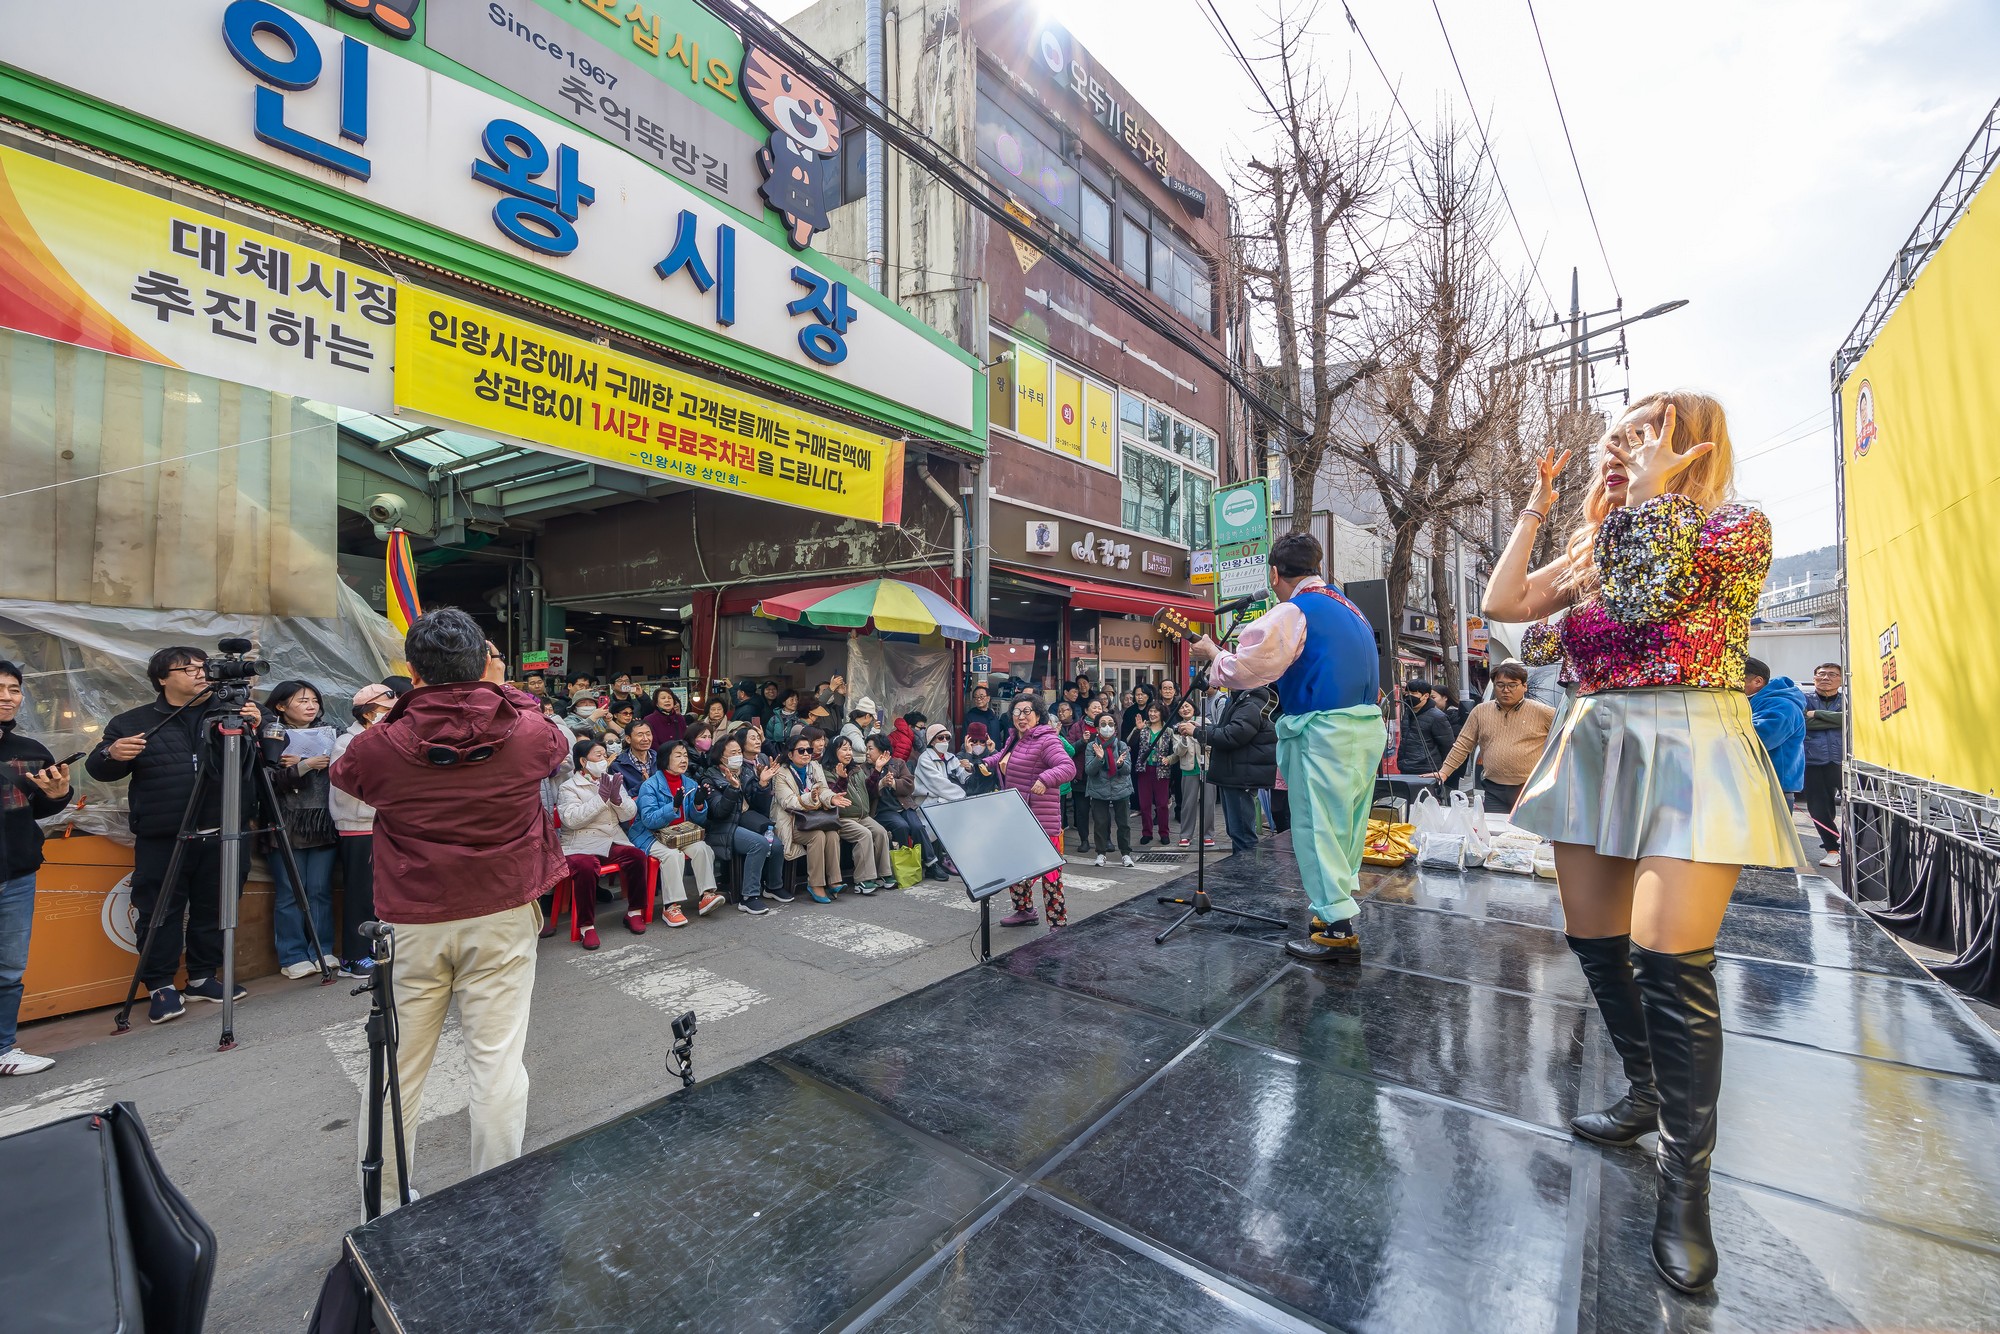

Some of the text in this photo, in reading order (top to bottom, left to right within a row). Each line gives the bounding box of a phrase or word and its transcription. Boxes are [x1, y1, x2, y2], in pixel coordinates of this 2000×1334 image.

[566, 0, 737, 103] 오십시오
[558, 75, 728, 194] 추억뚝방길
[1124, 111, 1169, 177] 당구장
[221, 0, 858, 366] 인왕시장
[1173, 180, 1203, 200] 394-5696
[172, 219, 396, 325] 대체시장
[131, 270, 374, 374] 추진하는
[428, 310, 871, 472] 인왕시장에서 구매한 고객분들께는 구매금액에
[474, 368, 847, 495] 상관없이 1시간 무료주차권을 드립니다.
[1018, 384, 1044, 407] 나루터
[1221, 554, 1265, 570] 인왕시장
[1241, 543, 1259, 557] 07
[978, 663, 988, 671] 18
[1102, 635, 1130, 647] TAKE
[1143, 639, 1163, 649] OUT
